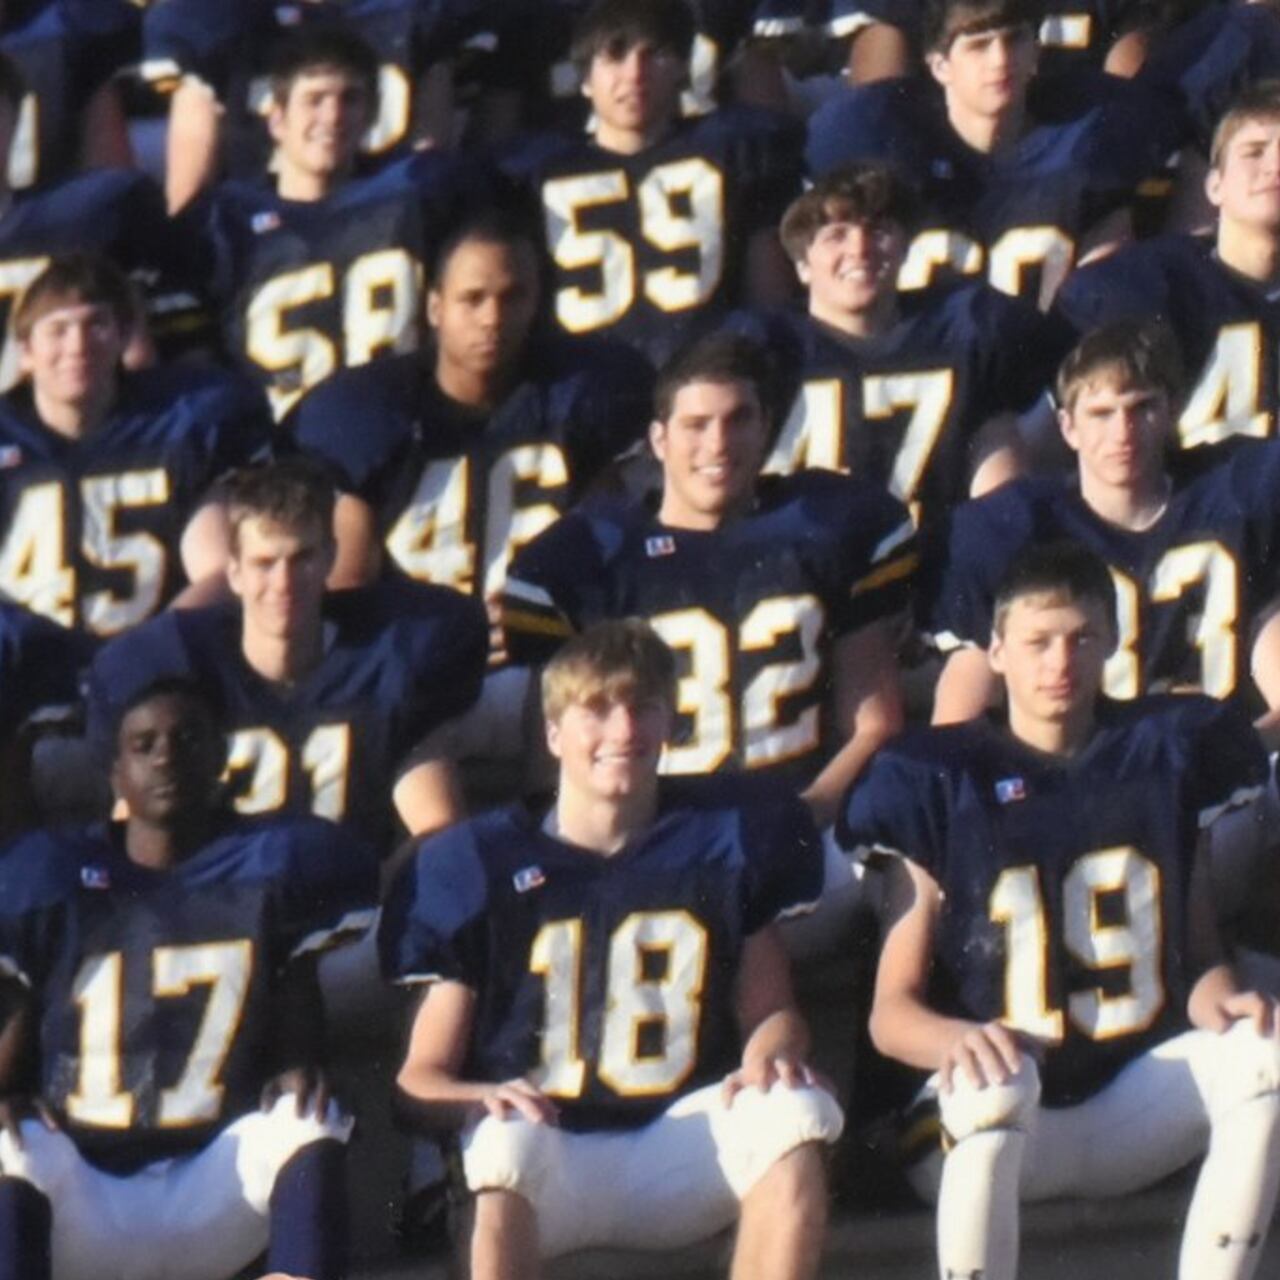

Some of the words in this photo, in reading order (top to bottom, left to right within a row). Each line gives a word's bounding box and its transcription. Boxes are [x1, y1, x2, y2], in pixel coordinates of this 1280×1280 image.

[541, 158, 724, 334] 59
[387, 443, 570, 598] 46
[762, 368, 955, 503] 47
[648, 594, 823, 775] 32
[67, 939, 253, 1129] 17
[529, 909, 708, 1098] 18
[990, 846, 1164, 1045] 19
